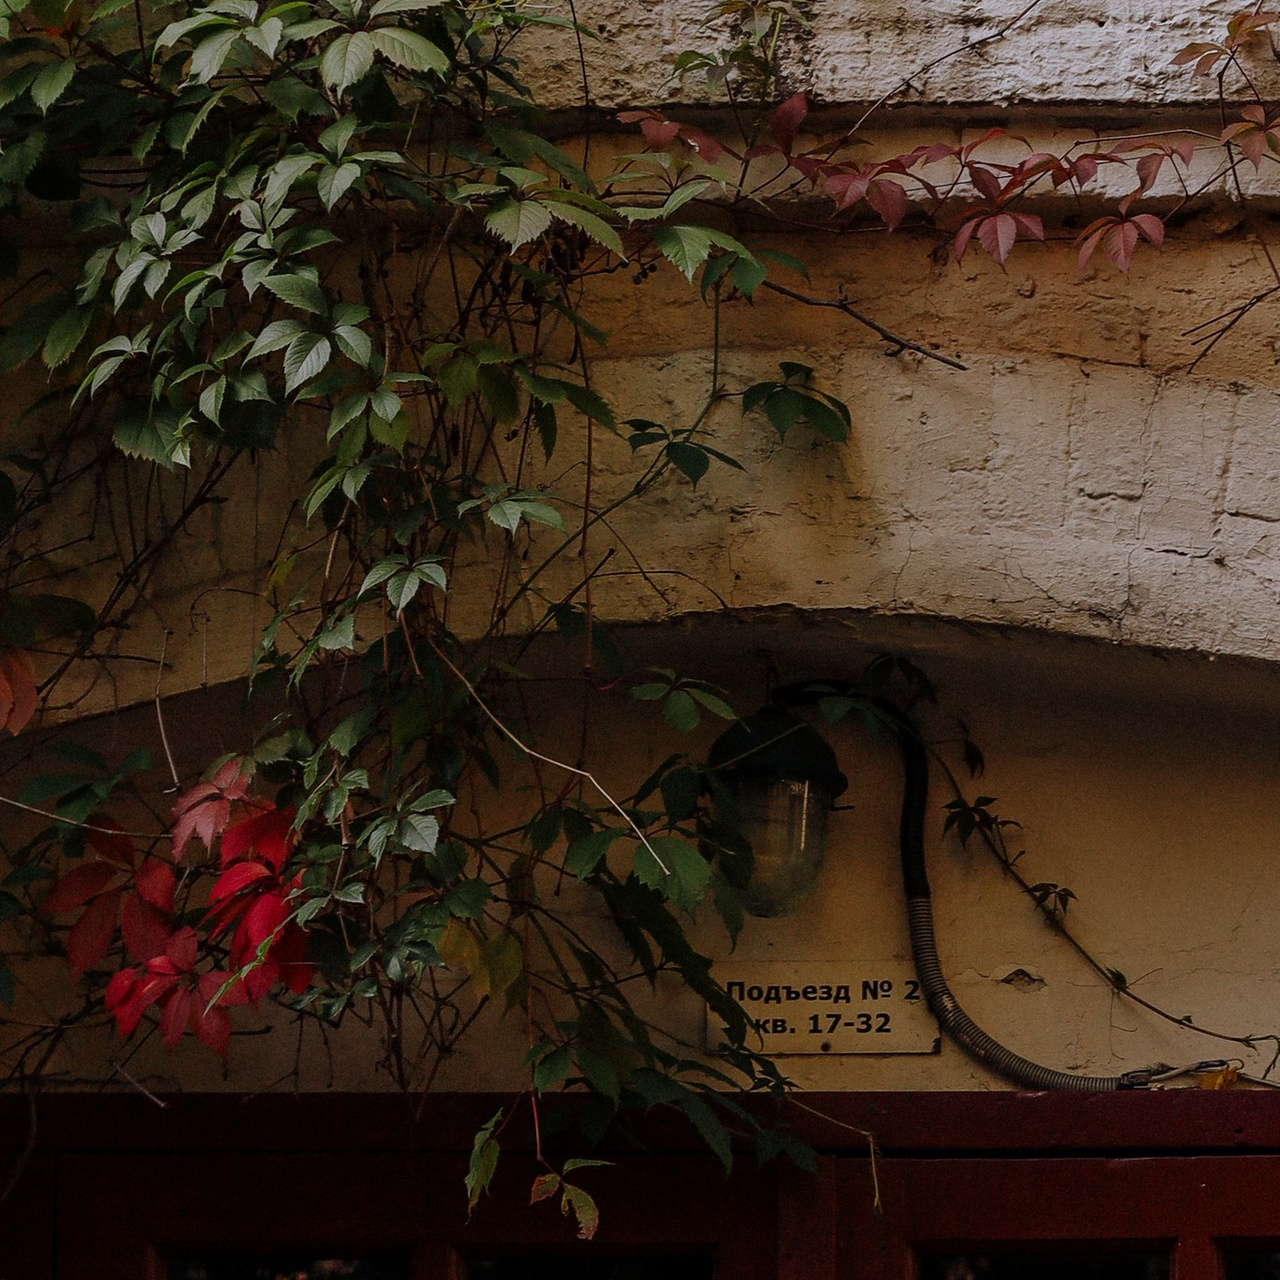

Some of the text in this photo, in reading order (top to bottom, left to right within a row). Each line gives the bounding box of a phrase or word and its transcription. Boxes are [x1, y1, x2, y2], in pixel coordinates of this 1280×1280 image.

[726, 980, 921, 1003] Подъезд № 2
[756, 1013, 892, 1034] кв. 17-32
